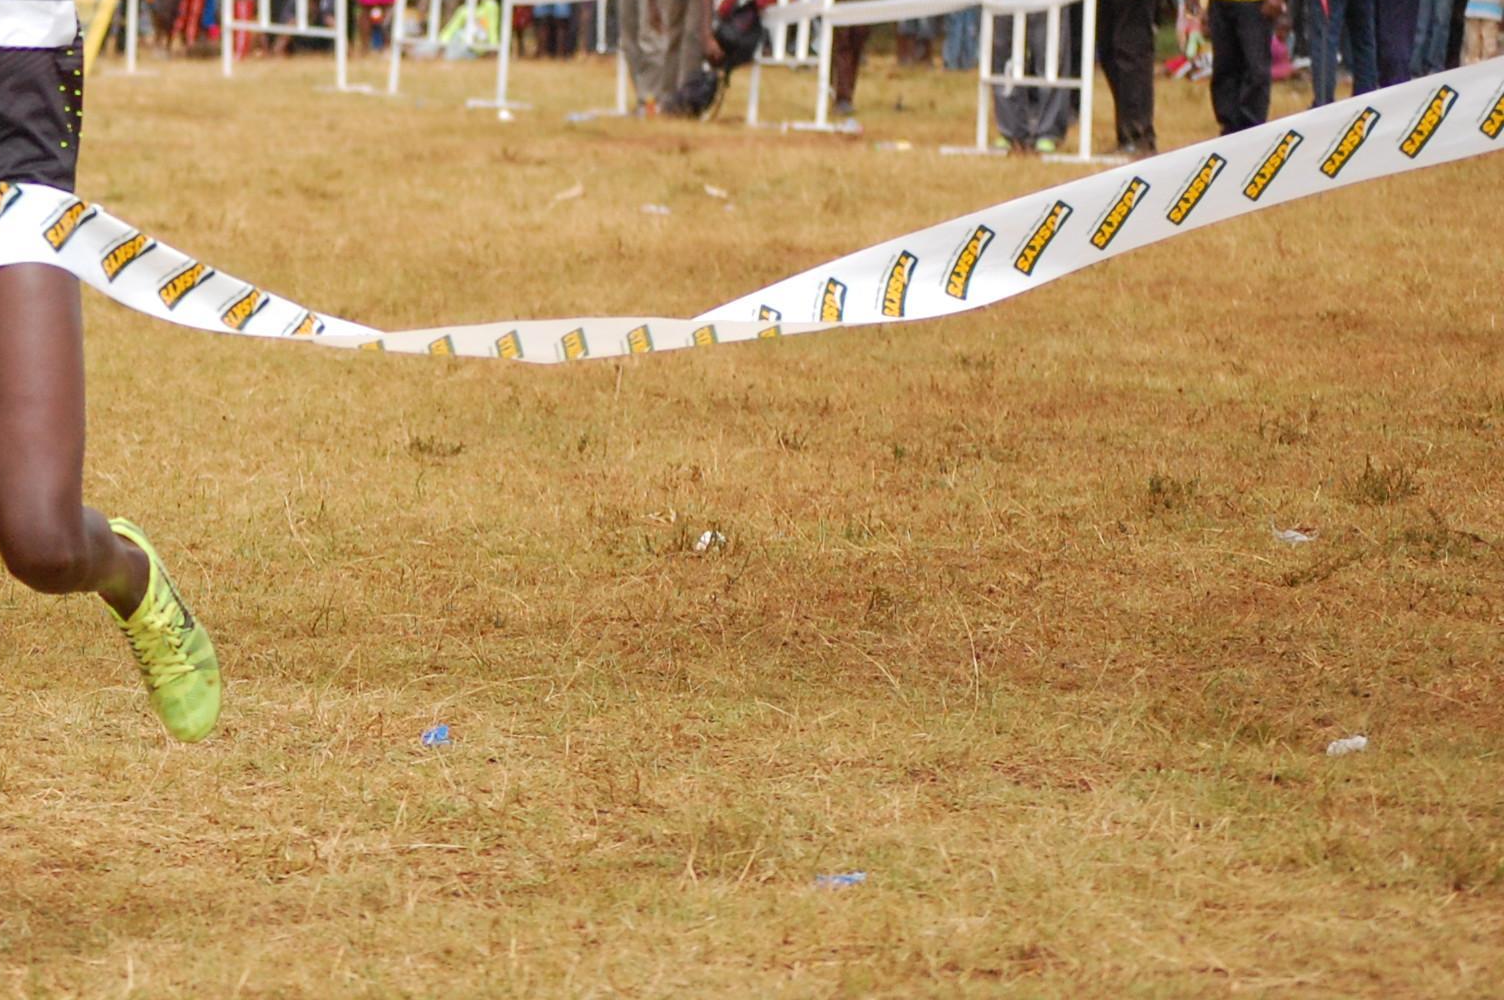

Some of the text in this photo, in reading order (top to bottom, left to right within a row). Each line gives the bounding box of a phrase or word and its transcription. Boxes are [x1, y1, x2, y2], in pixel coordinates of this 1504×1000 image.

[1322, 110, 1372, 176] TUSKYS
[1401, 88, 1449, 157] TUSKYS
[1168, 157, 1217, 224] TUSKYS
[1244, 133, 1295, 200] TUSKYS
[46, 200, 89, 249] USKYS
[1016, 204, 1063, 274] TUSKYS
[1092, 181, 1139, 248] TUSKYS
[102, 233, 147, 279] USKYS
[159, 262, 205, 307] USKYS
[947, 228, 986, 298] TUSKYS
